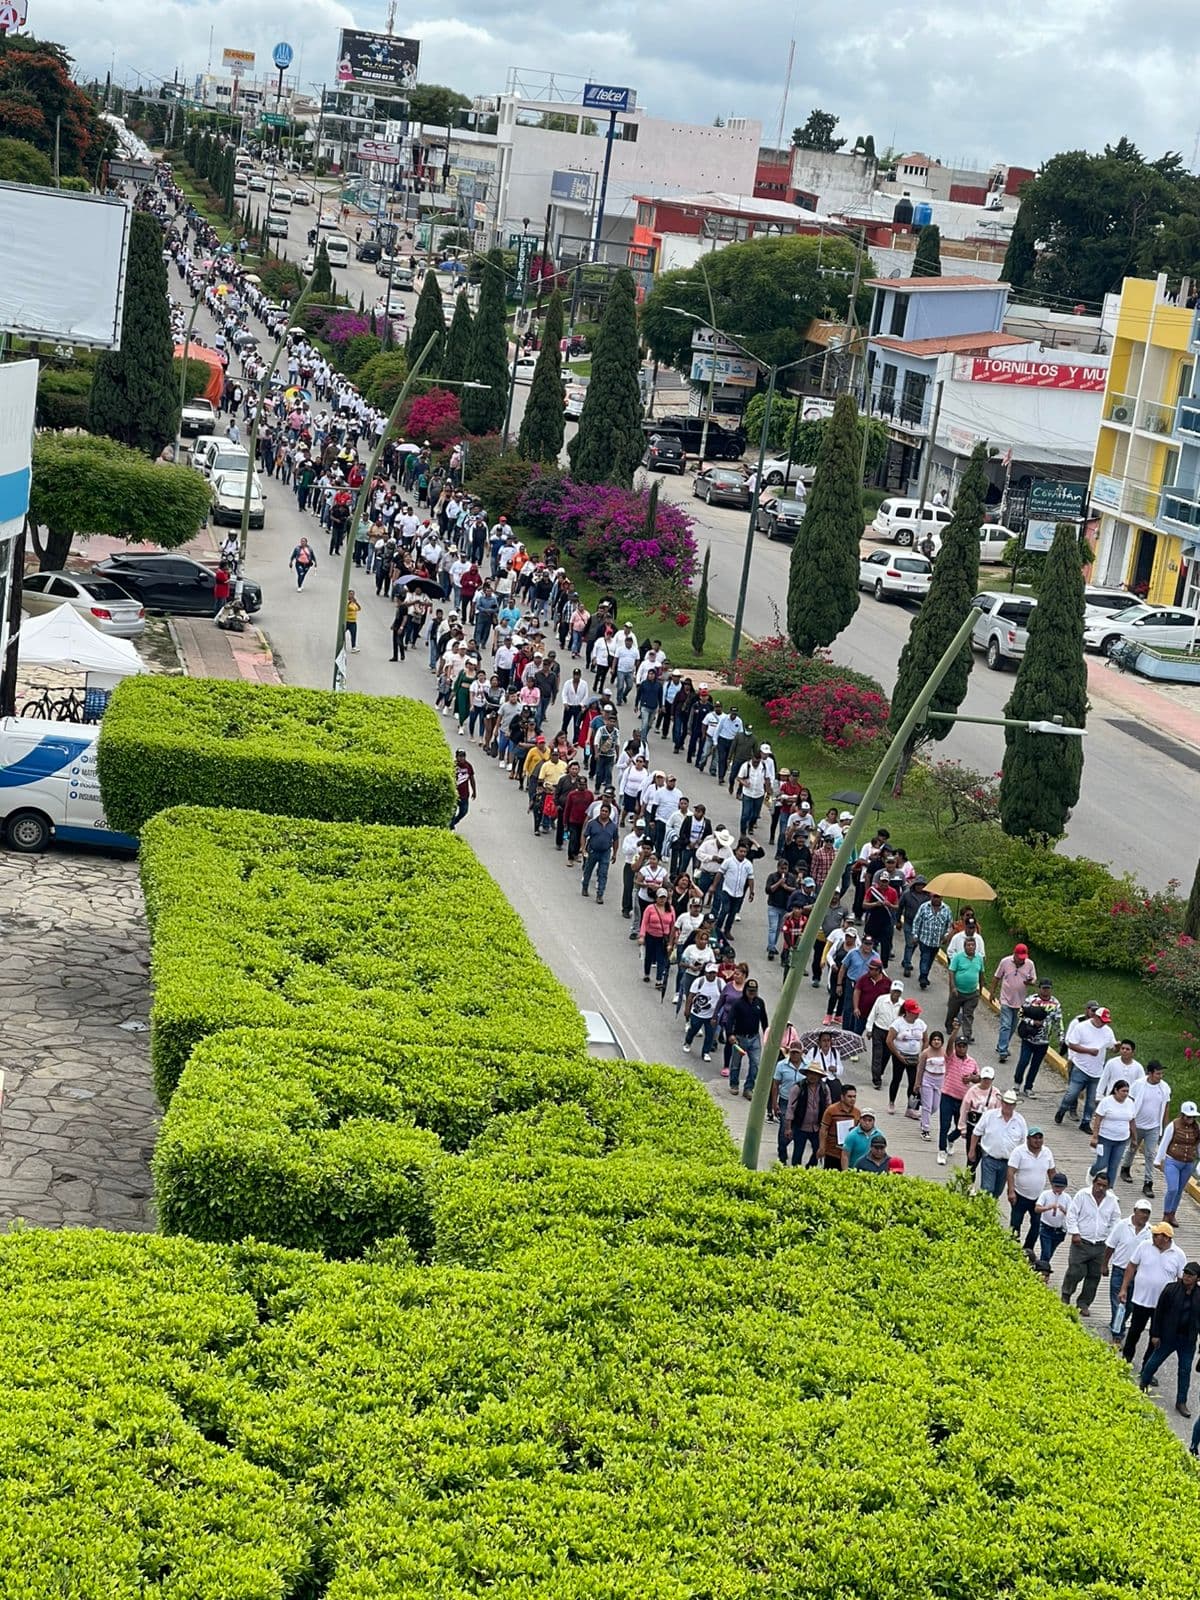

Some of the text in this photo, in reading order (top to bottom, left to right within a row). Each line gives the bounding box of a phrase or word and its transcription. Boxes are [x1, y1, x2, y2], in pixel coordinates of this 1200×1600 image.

[596, 88, 626, 102] telcel
[1069, 367, 1079, 378] Y
[1083, 368, 1107, 381] MU
[1032, 486, 1082, 501] Comitán
